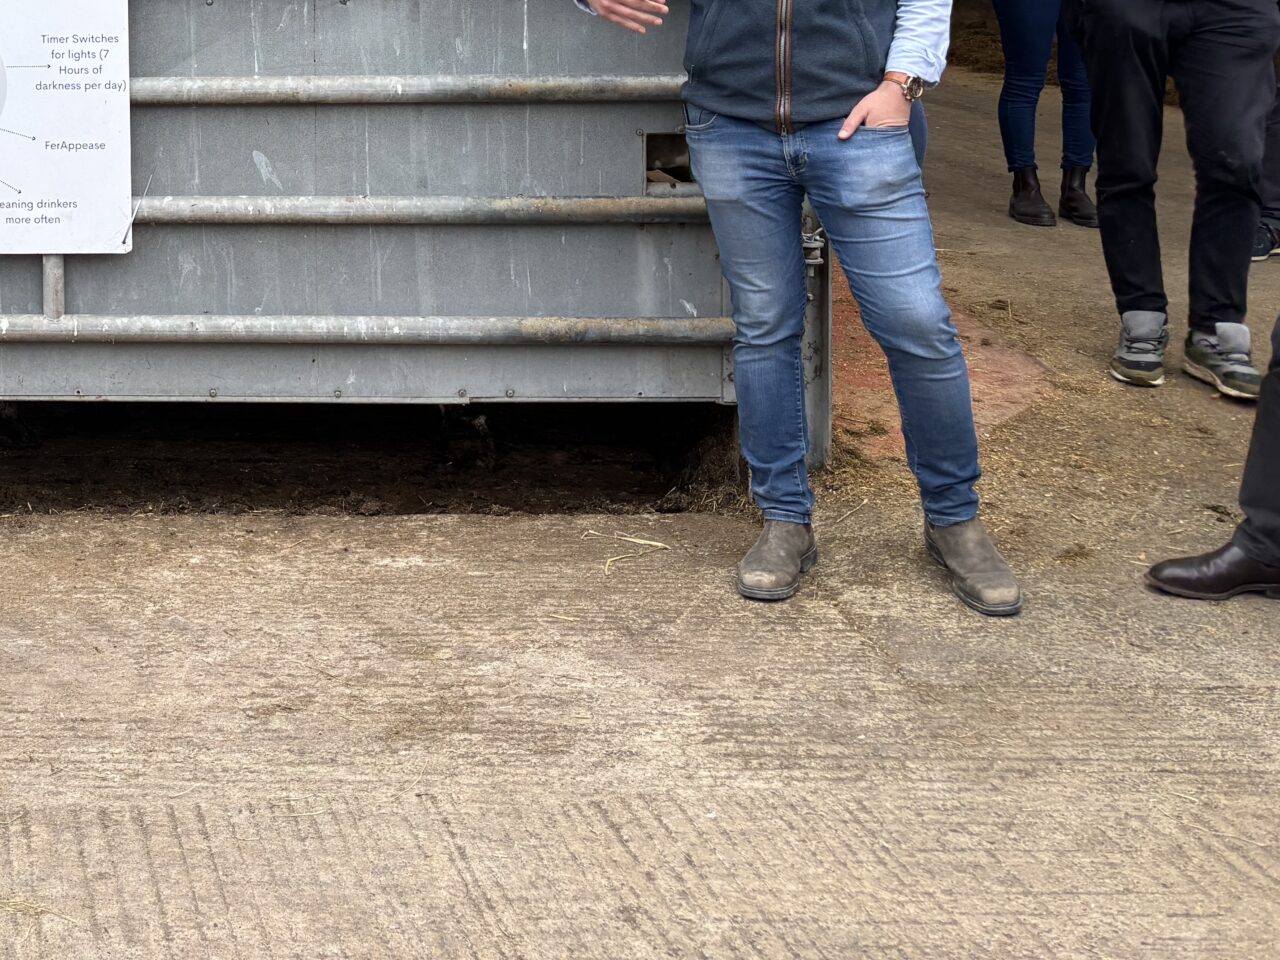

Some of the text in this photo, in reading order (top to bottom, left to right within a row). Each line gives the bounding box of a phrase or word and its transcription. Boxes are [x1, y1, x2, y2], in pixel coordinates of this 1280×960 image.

[41, 34, 119, 43] Timer Switches
[51, 49, 109, 62] for lights (7
[59, 64, 102, 75] Hours of
[35, 80, 127, 92] darkness per day)
[45, 141, 105, 152] FerAppease
[37, 199, 78, 209] drinkers
[6, 214, 60, 224] more often
